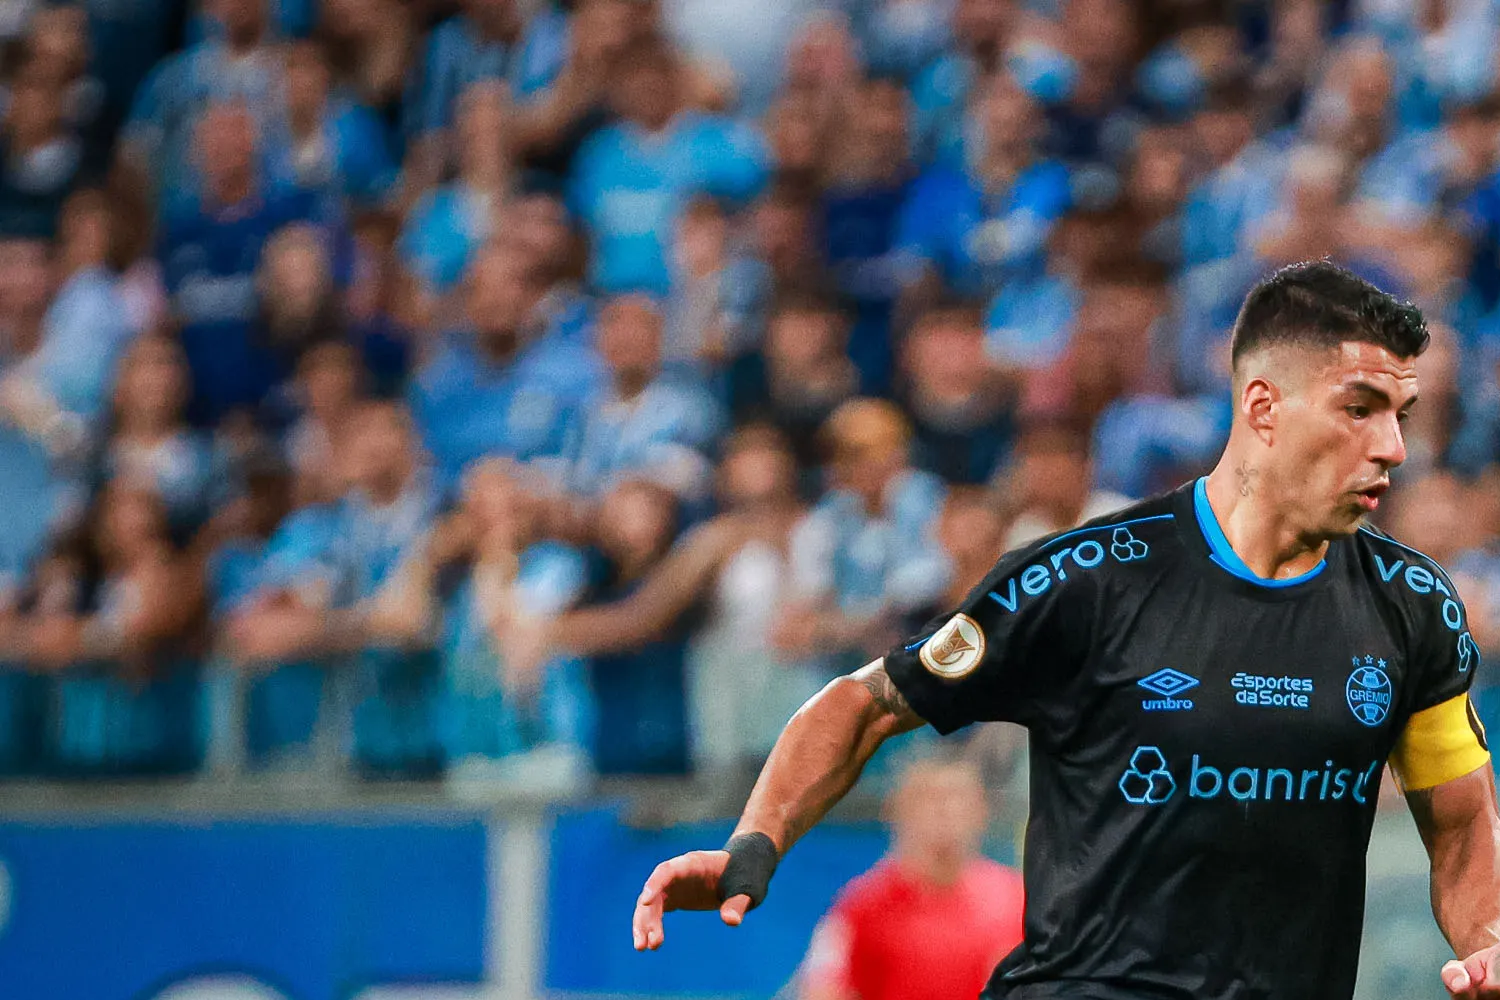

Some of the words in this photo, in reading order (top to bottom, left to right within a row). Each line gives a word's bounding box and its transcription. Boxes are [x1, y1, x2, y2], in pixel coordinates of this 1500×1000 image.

[988, 540, 1104, 612] vero
[1374, 554, 1462, 630] vero
[1142, 698, 1193, 711] umbro
[1230, 672, 1313, 692] Esportes
